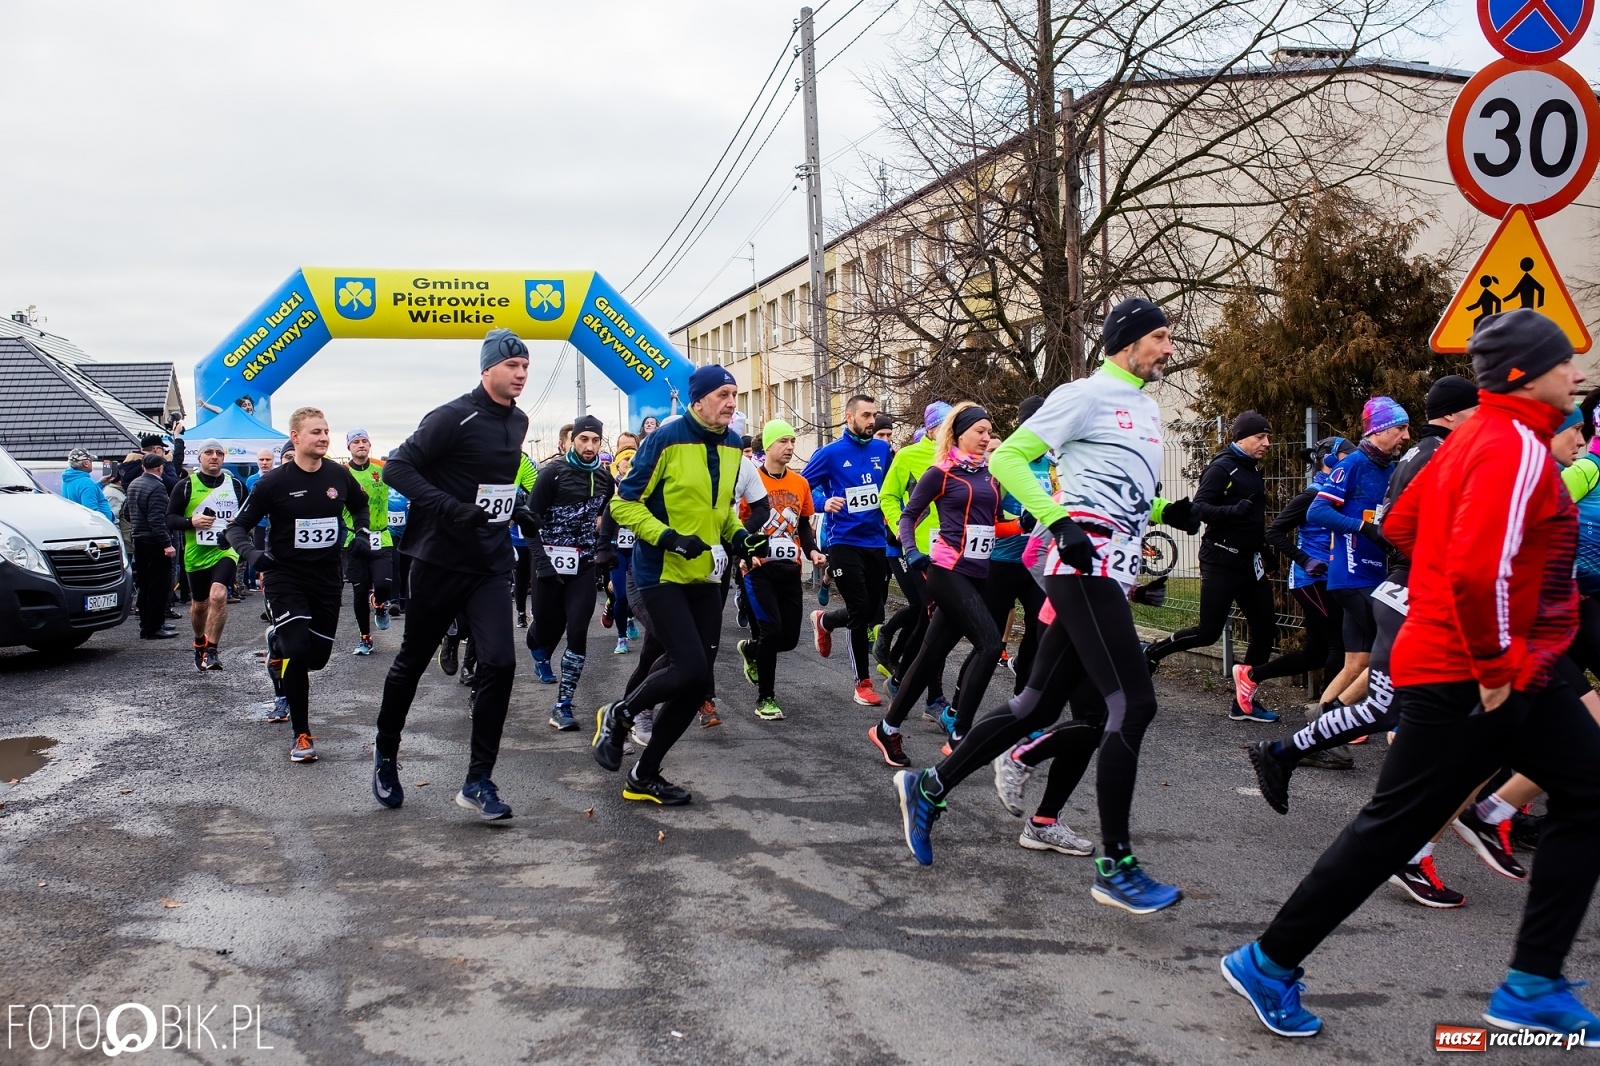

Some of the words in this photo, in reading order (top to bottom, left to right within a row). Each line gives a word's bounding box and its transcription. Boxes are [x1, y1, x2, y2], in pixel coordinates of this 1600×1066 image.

[1473, 97, 1578, 178] 30
[412, 277, 489, 290] Gmina
[392, 292, 510, 307] Pietrowice
[408, 309, 495, 323] Wielkie
[223, 325, 269, 368] Gmina
[264, 290, 305, 329] ludzi
[594, 296, 636, 339] Gmina
[634, 333, 672, 370] ludzi
[241, 307, 317, 382] aktywnych
[582, 312, 656, 383] aktywnych
[860, 472, 873, 485] 18
[479, 497, 513, 515] 280
[849, 493, 878, 508] 450
[298, 528, 336, 543] 332
[832, 568, 843, 577] 18
